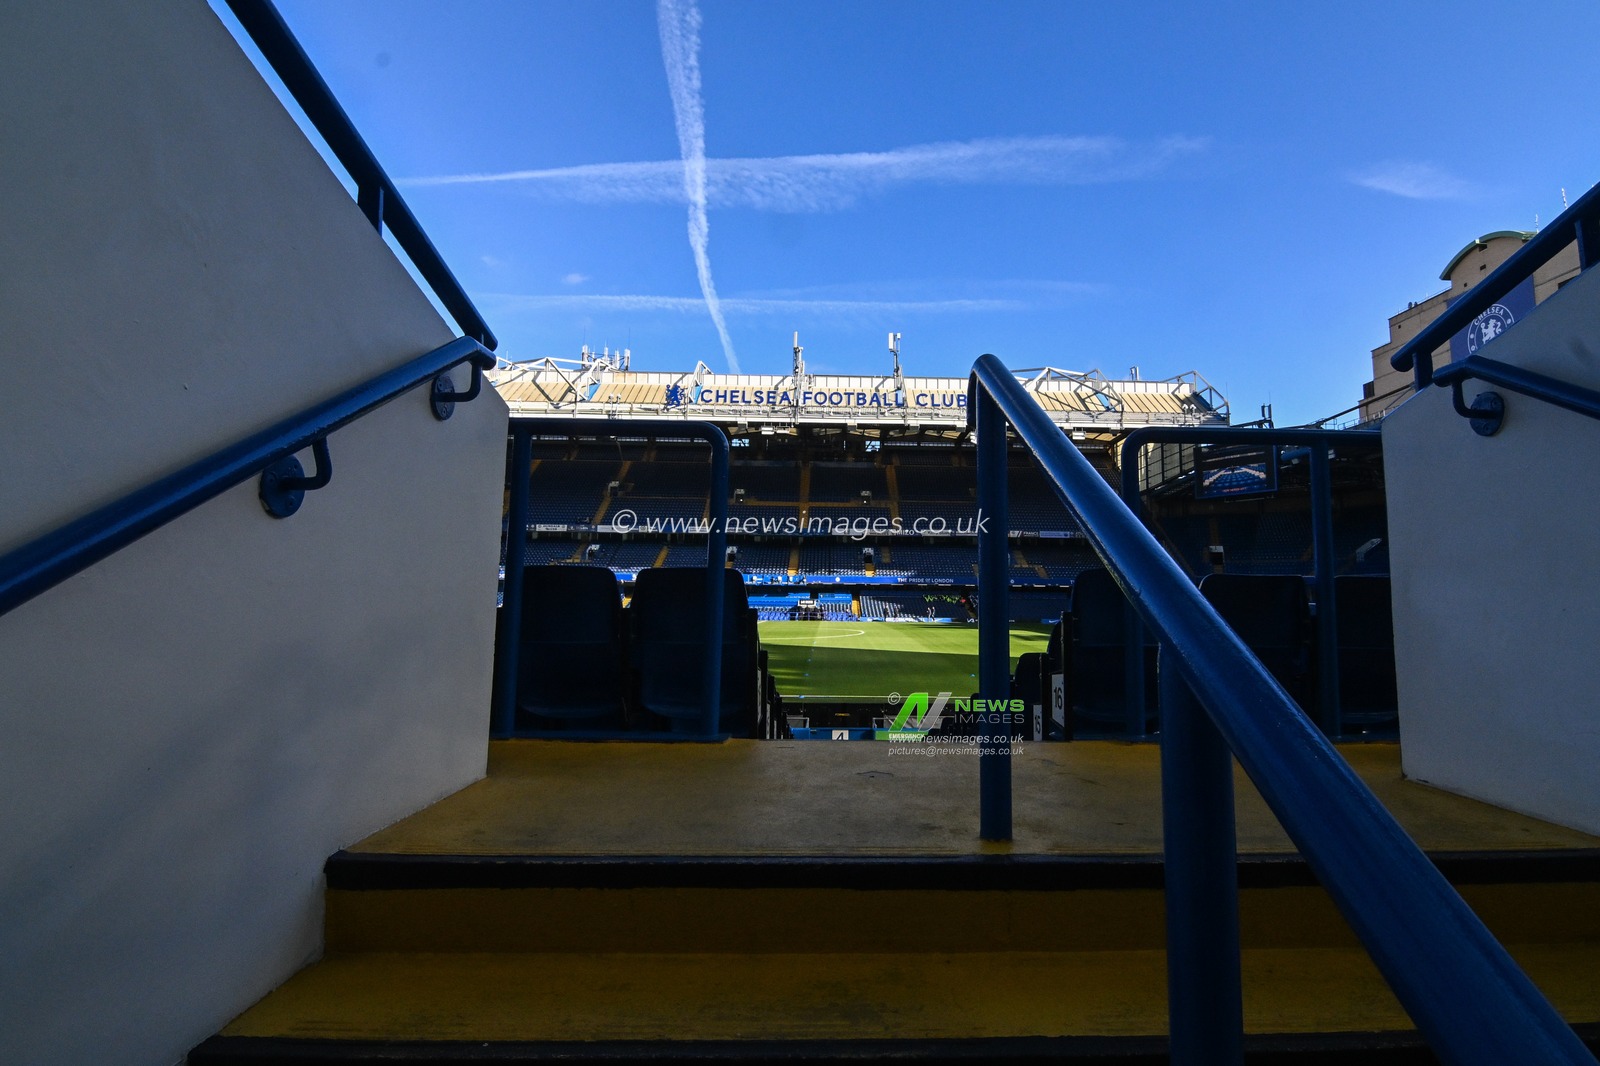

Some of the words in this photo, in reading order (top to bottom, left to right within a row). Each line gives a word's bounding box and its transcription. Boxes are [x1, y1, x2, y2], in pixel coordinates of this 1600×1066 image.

[1474, 306, 1504, 326] CHELSEA
[700, 389, 793, 405] CHELSEA
[803, 390, 905, 407] FOOTBALL
[916, 393, 967, 408] CLUB
[1053, 686, 1063, 711] 16
